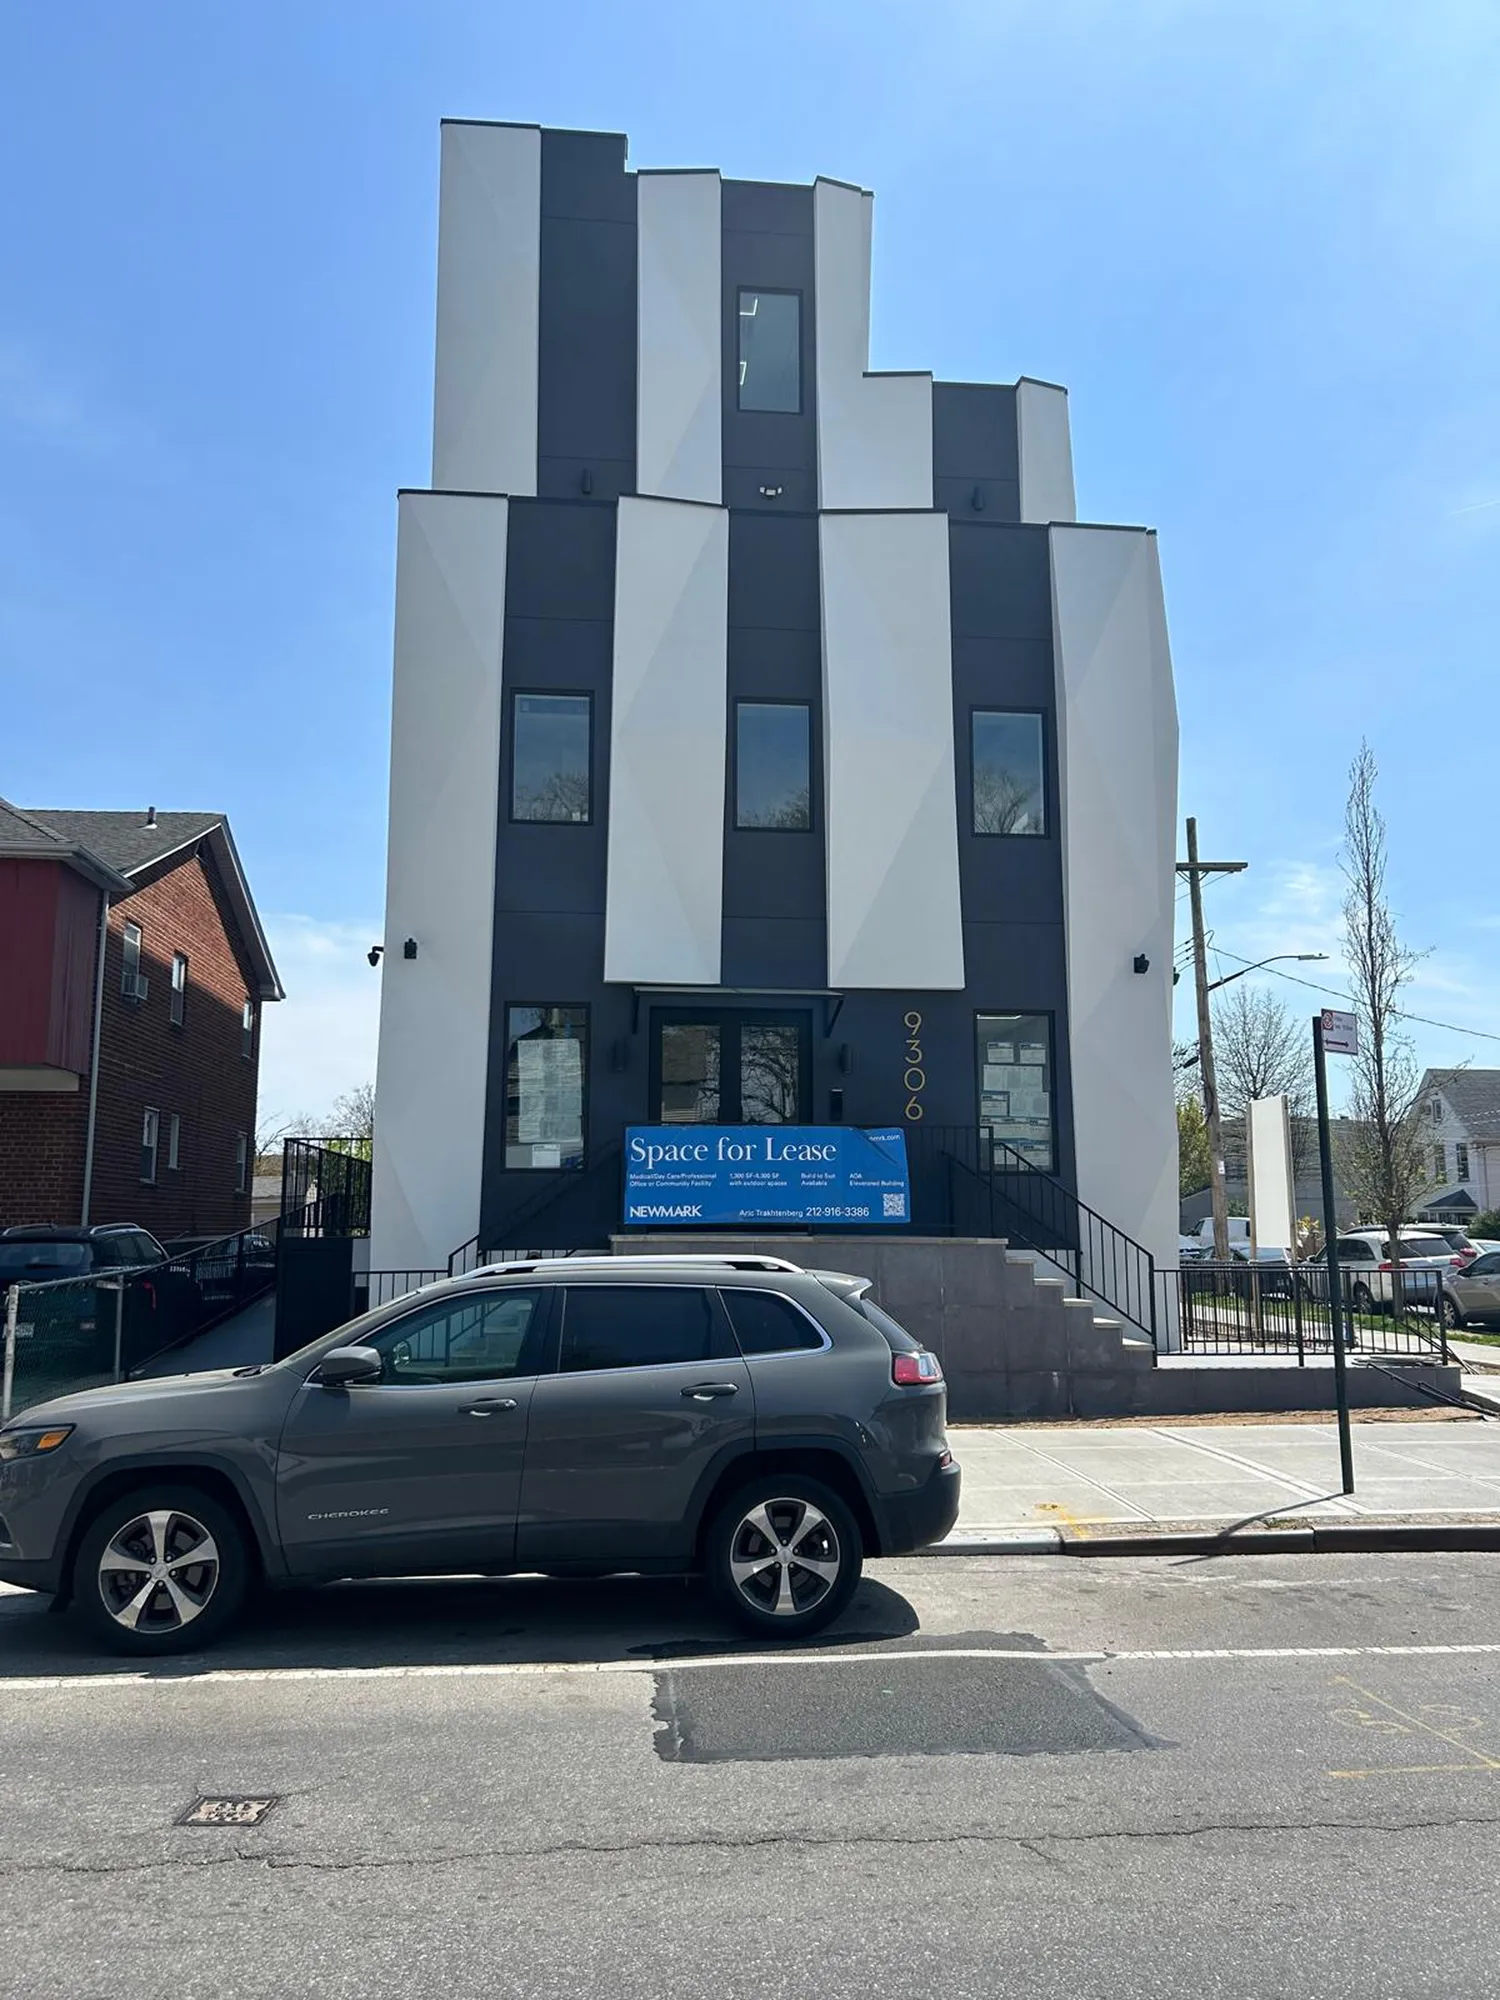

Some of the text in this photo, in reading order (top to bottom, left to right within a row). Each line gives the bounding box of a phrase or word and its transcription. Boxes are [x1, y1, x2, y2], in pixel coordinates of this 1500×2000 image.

[903, 1011, 926, 1121] 9306
[630, 1136, 837, 1169] Space for Lease
[629, 1180, 647, 1188] Office
[655, 1180, 690, 1188] Community
[690, 1180, 713, 1188] Facility
[880, 1180, 905, 1188] Building
[629, 1204, 702, 1218] NEWMARK
[739, 1206, 870, 1218] Aric Trakhtenberg 212-916-3386
[307, 1508, 390, 1520] CHEROKEE
